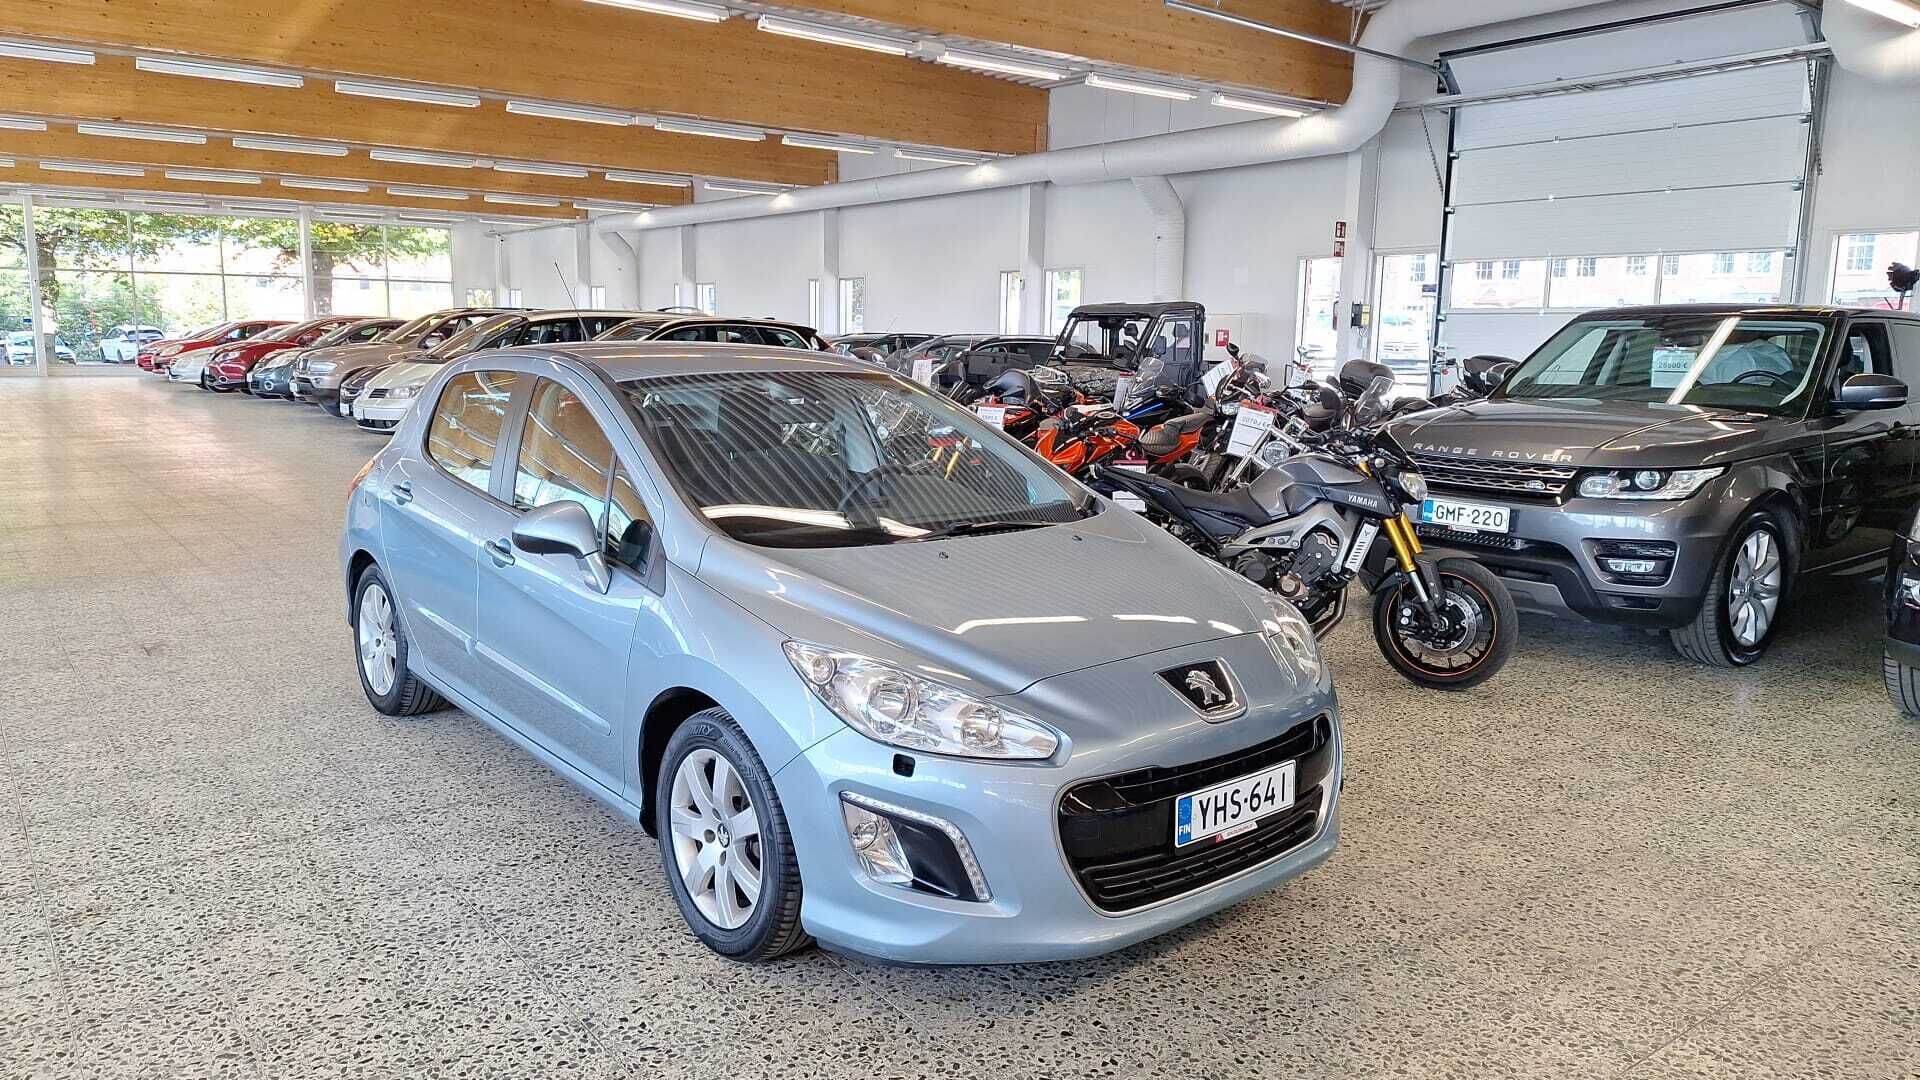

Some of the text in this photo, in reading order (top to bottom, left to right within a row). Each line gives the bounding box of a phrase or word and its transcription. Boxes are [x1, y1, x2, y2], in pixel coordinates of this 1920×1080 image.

[1413, 442, 1573, 463] RANGE ROVER
[1348, 494, 1378, 509] YAMAHA
[1198, 771, 1286, 830] YHS-641
[1179, 823, 1192, 836] FIN
